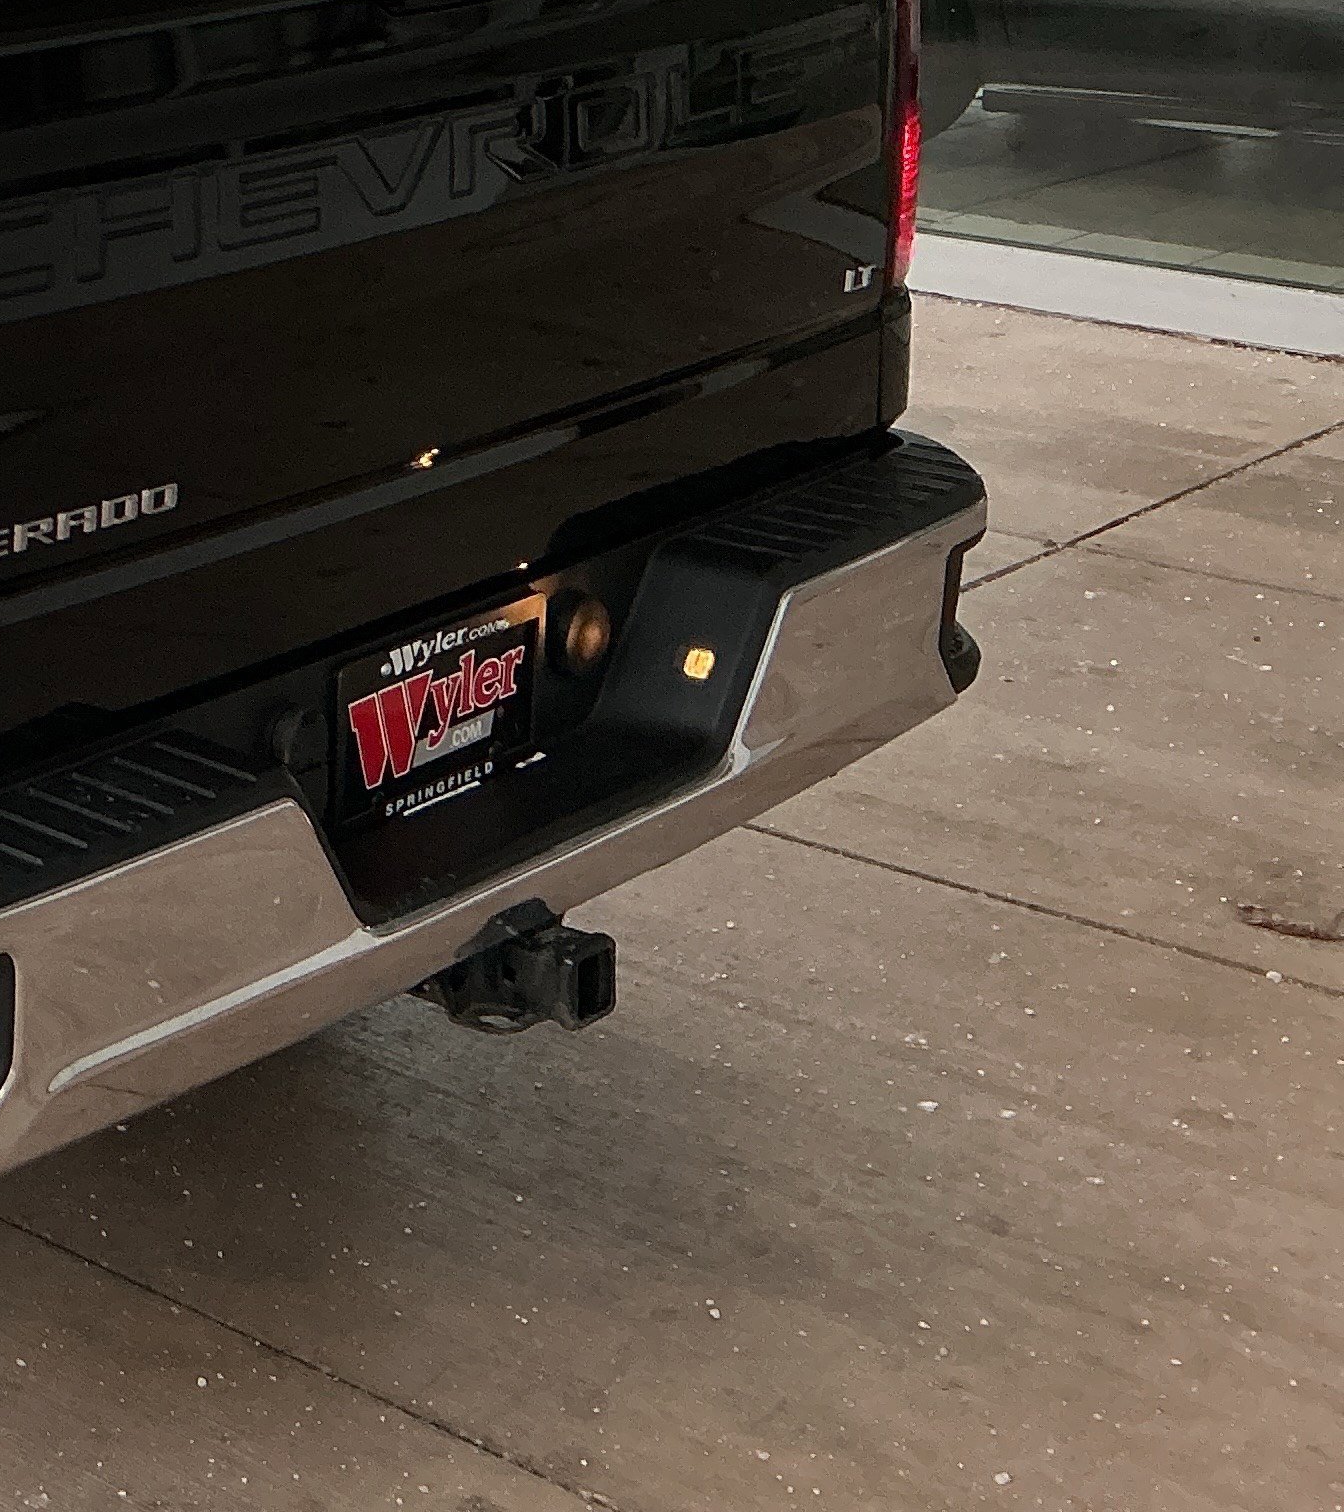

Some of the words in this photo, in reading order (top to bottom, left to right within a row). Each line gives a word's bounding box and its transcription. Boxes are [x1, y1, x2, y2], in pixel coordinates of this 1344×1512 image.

[843, 264, 877, 294] LT
[347, 645, 526, 790] Wyler
[384, 760, 494, 818] SPRINGFIELD
